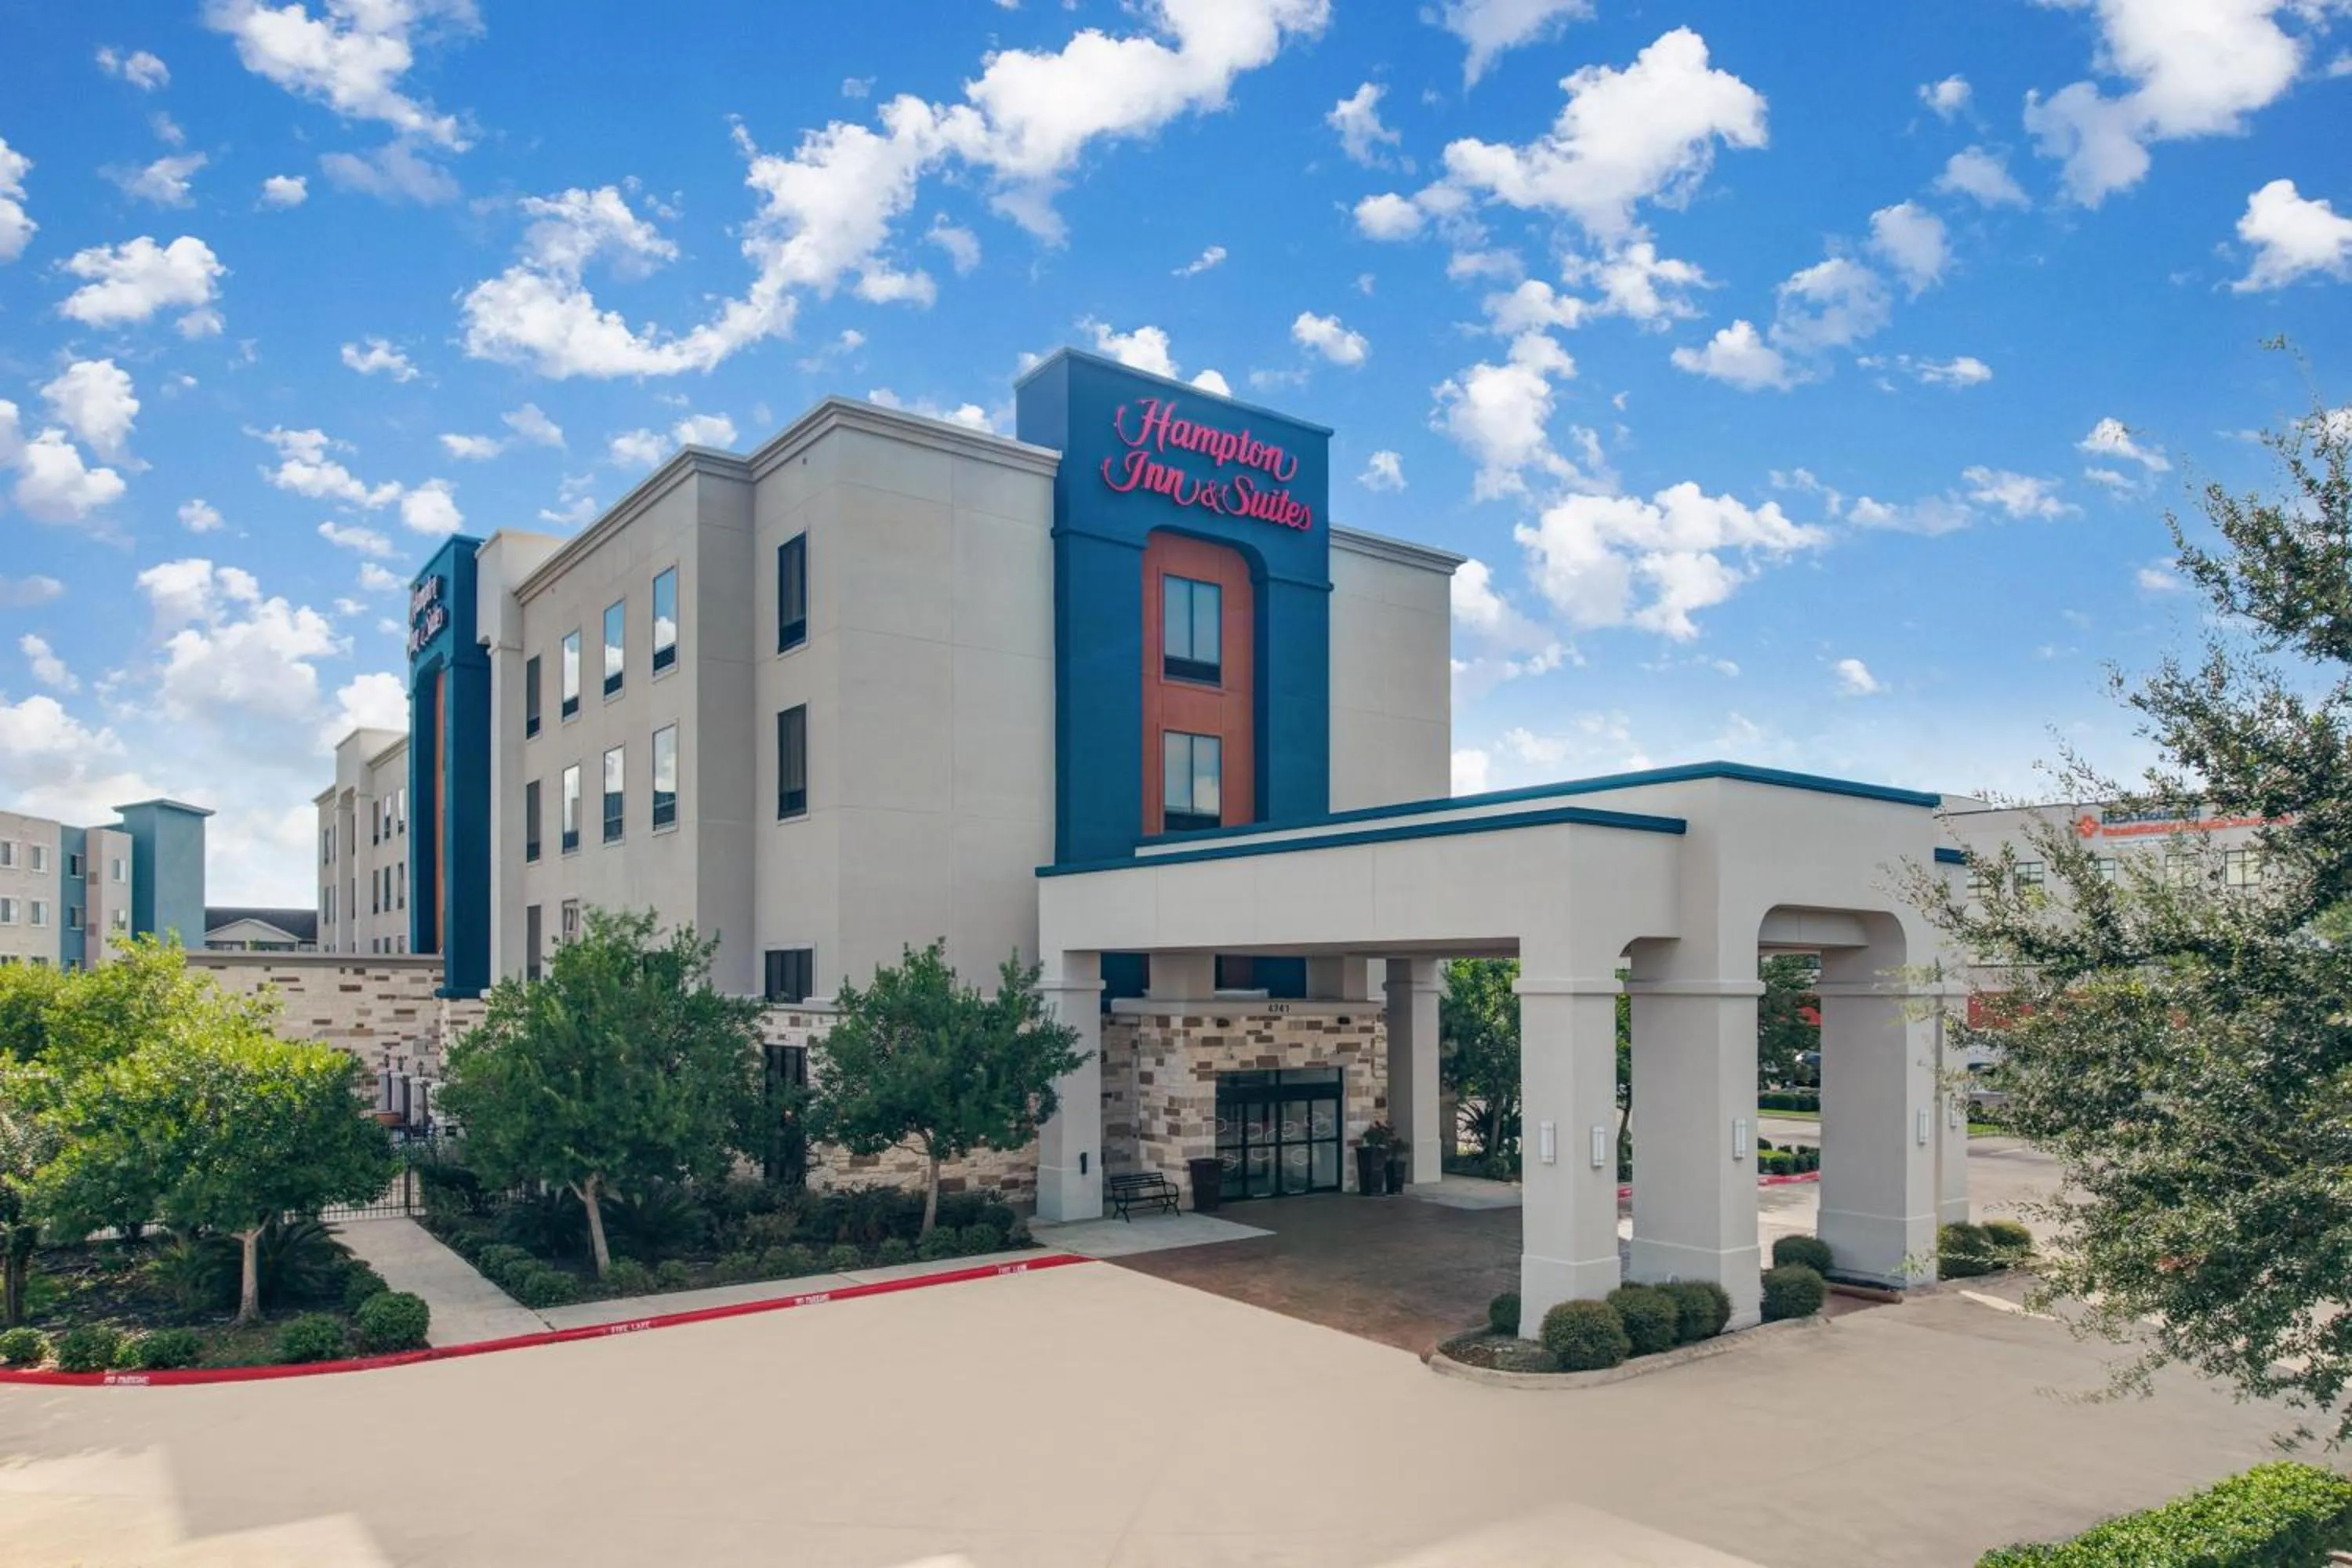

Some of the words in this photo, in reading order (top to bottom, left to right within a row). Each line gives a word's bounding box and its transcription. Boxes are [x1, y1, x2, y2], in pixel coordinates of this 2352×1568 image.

[1113, 397, 1298, 483] Hampton
[1101, 451, 1200, 506] Inn
[1200, 480, 1225, 514] &
[1222, 474, 1312, 530] Suites
